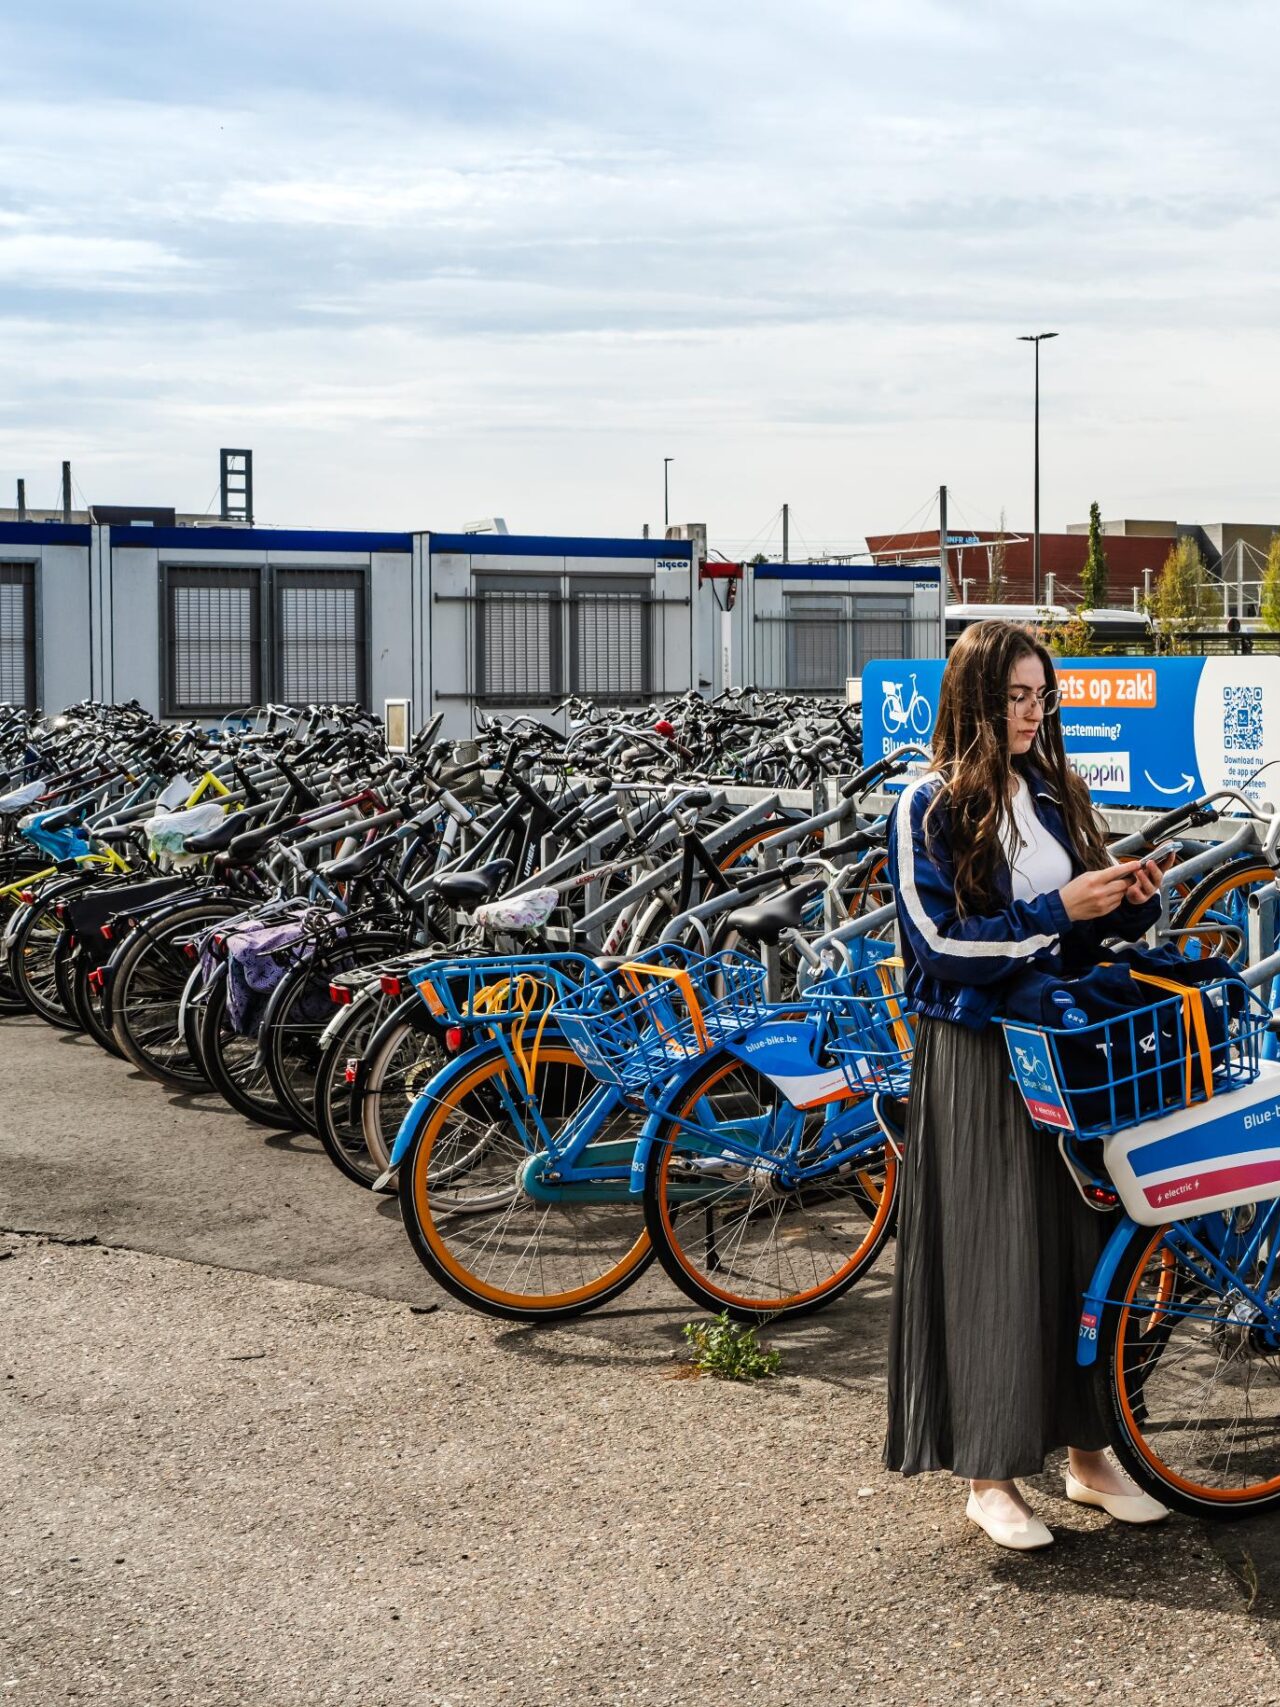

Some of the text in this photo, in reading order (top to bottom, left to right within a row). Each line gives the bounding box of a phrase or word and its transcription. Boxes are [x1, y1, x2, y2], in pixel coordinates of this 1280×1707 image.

[1089, 679, 1112, 706] op
[1116, 673, 1153, 700] zak!
[1061, 722, 1121, 741] bestemming?
[1223, 755, 1254, 765] Download
[1228, 767, 1235, 776] de
[1237, 768, 1249, 777] app
[746, 1035, 797, 1053] blue-bike.be
[1164, 1182, 1192, 1200] electric
